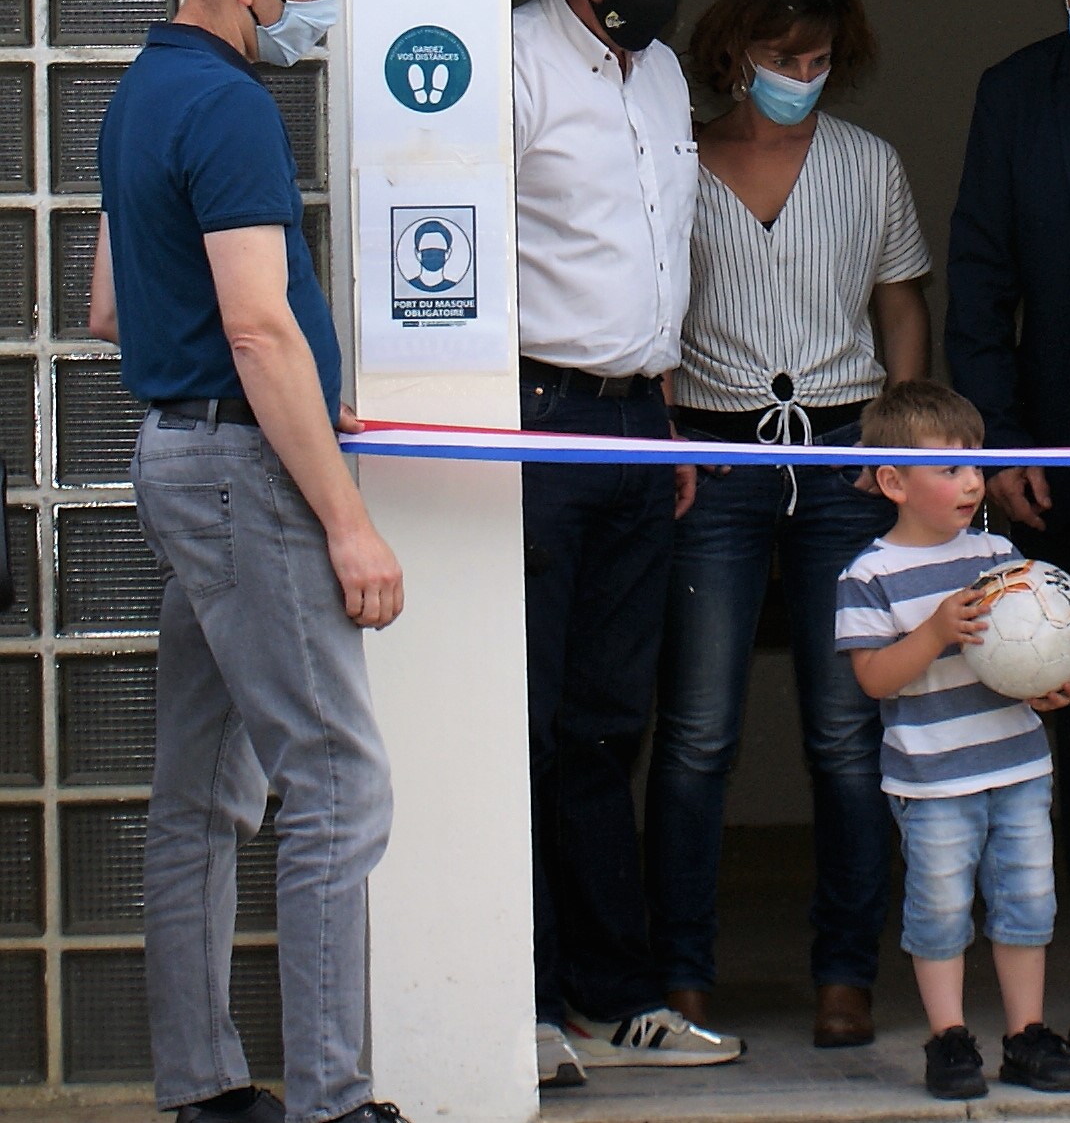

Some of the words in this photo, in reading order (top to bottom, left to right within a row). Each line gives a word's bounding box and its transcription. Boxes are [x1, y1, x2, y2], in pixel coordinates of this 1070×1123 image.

[412, 45, 443, 53] GARDEZ
[397, 53, 414, 61] VOS
[415, 53, 459, 61] DISTANCES
[394, 300, 417, 308] PORT
[419, 300, 433, 308] DU
[435, 300, 475, 308] MASQUE
[404, 309, 464, 317] OBLIGATOIRE
